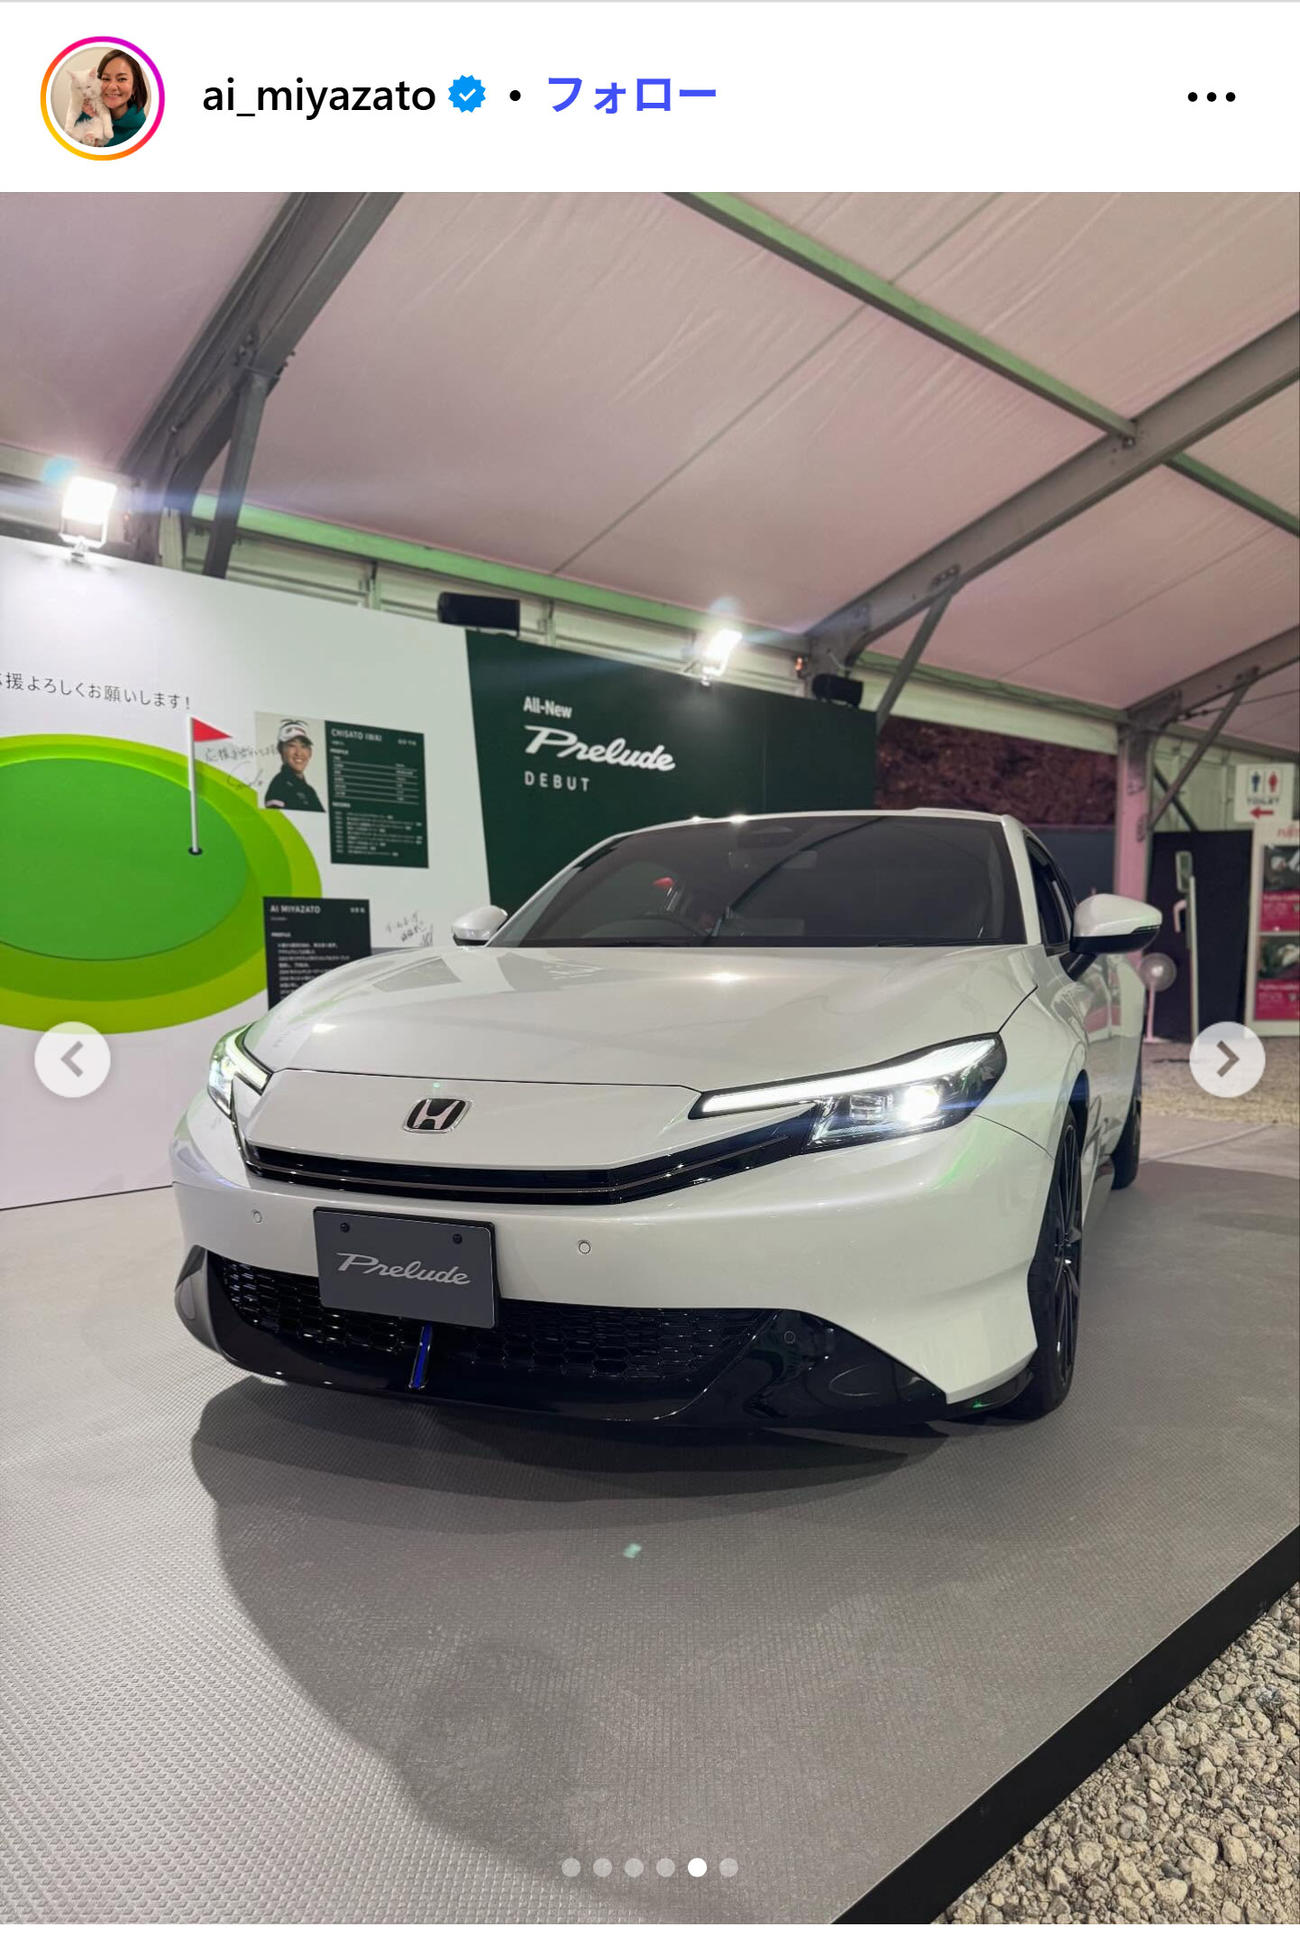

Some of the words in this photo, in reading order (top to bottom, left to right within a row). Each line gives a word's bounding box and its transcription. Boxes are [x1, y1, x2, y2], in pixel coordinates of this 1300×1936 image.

[523, 696, 573, 719] All-New
[524, 725, 676, 772] Prelude
[524, 770, 590, 792] DEBUT
[280, 904, 321, 915] MIYAZATO
[336, 1251, 471, 1286] Prelude
